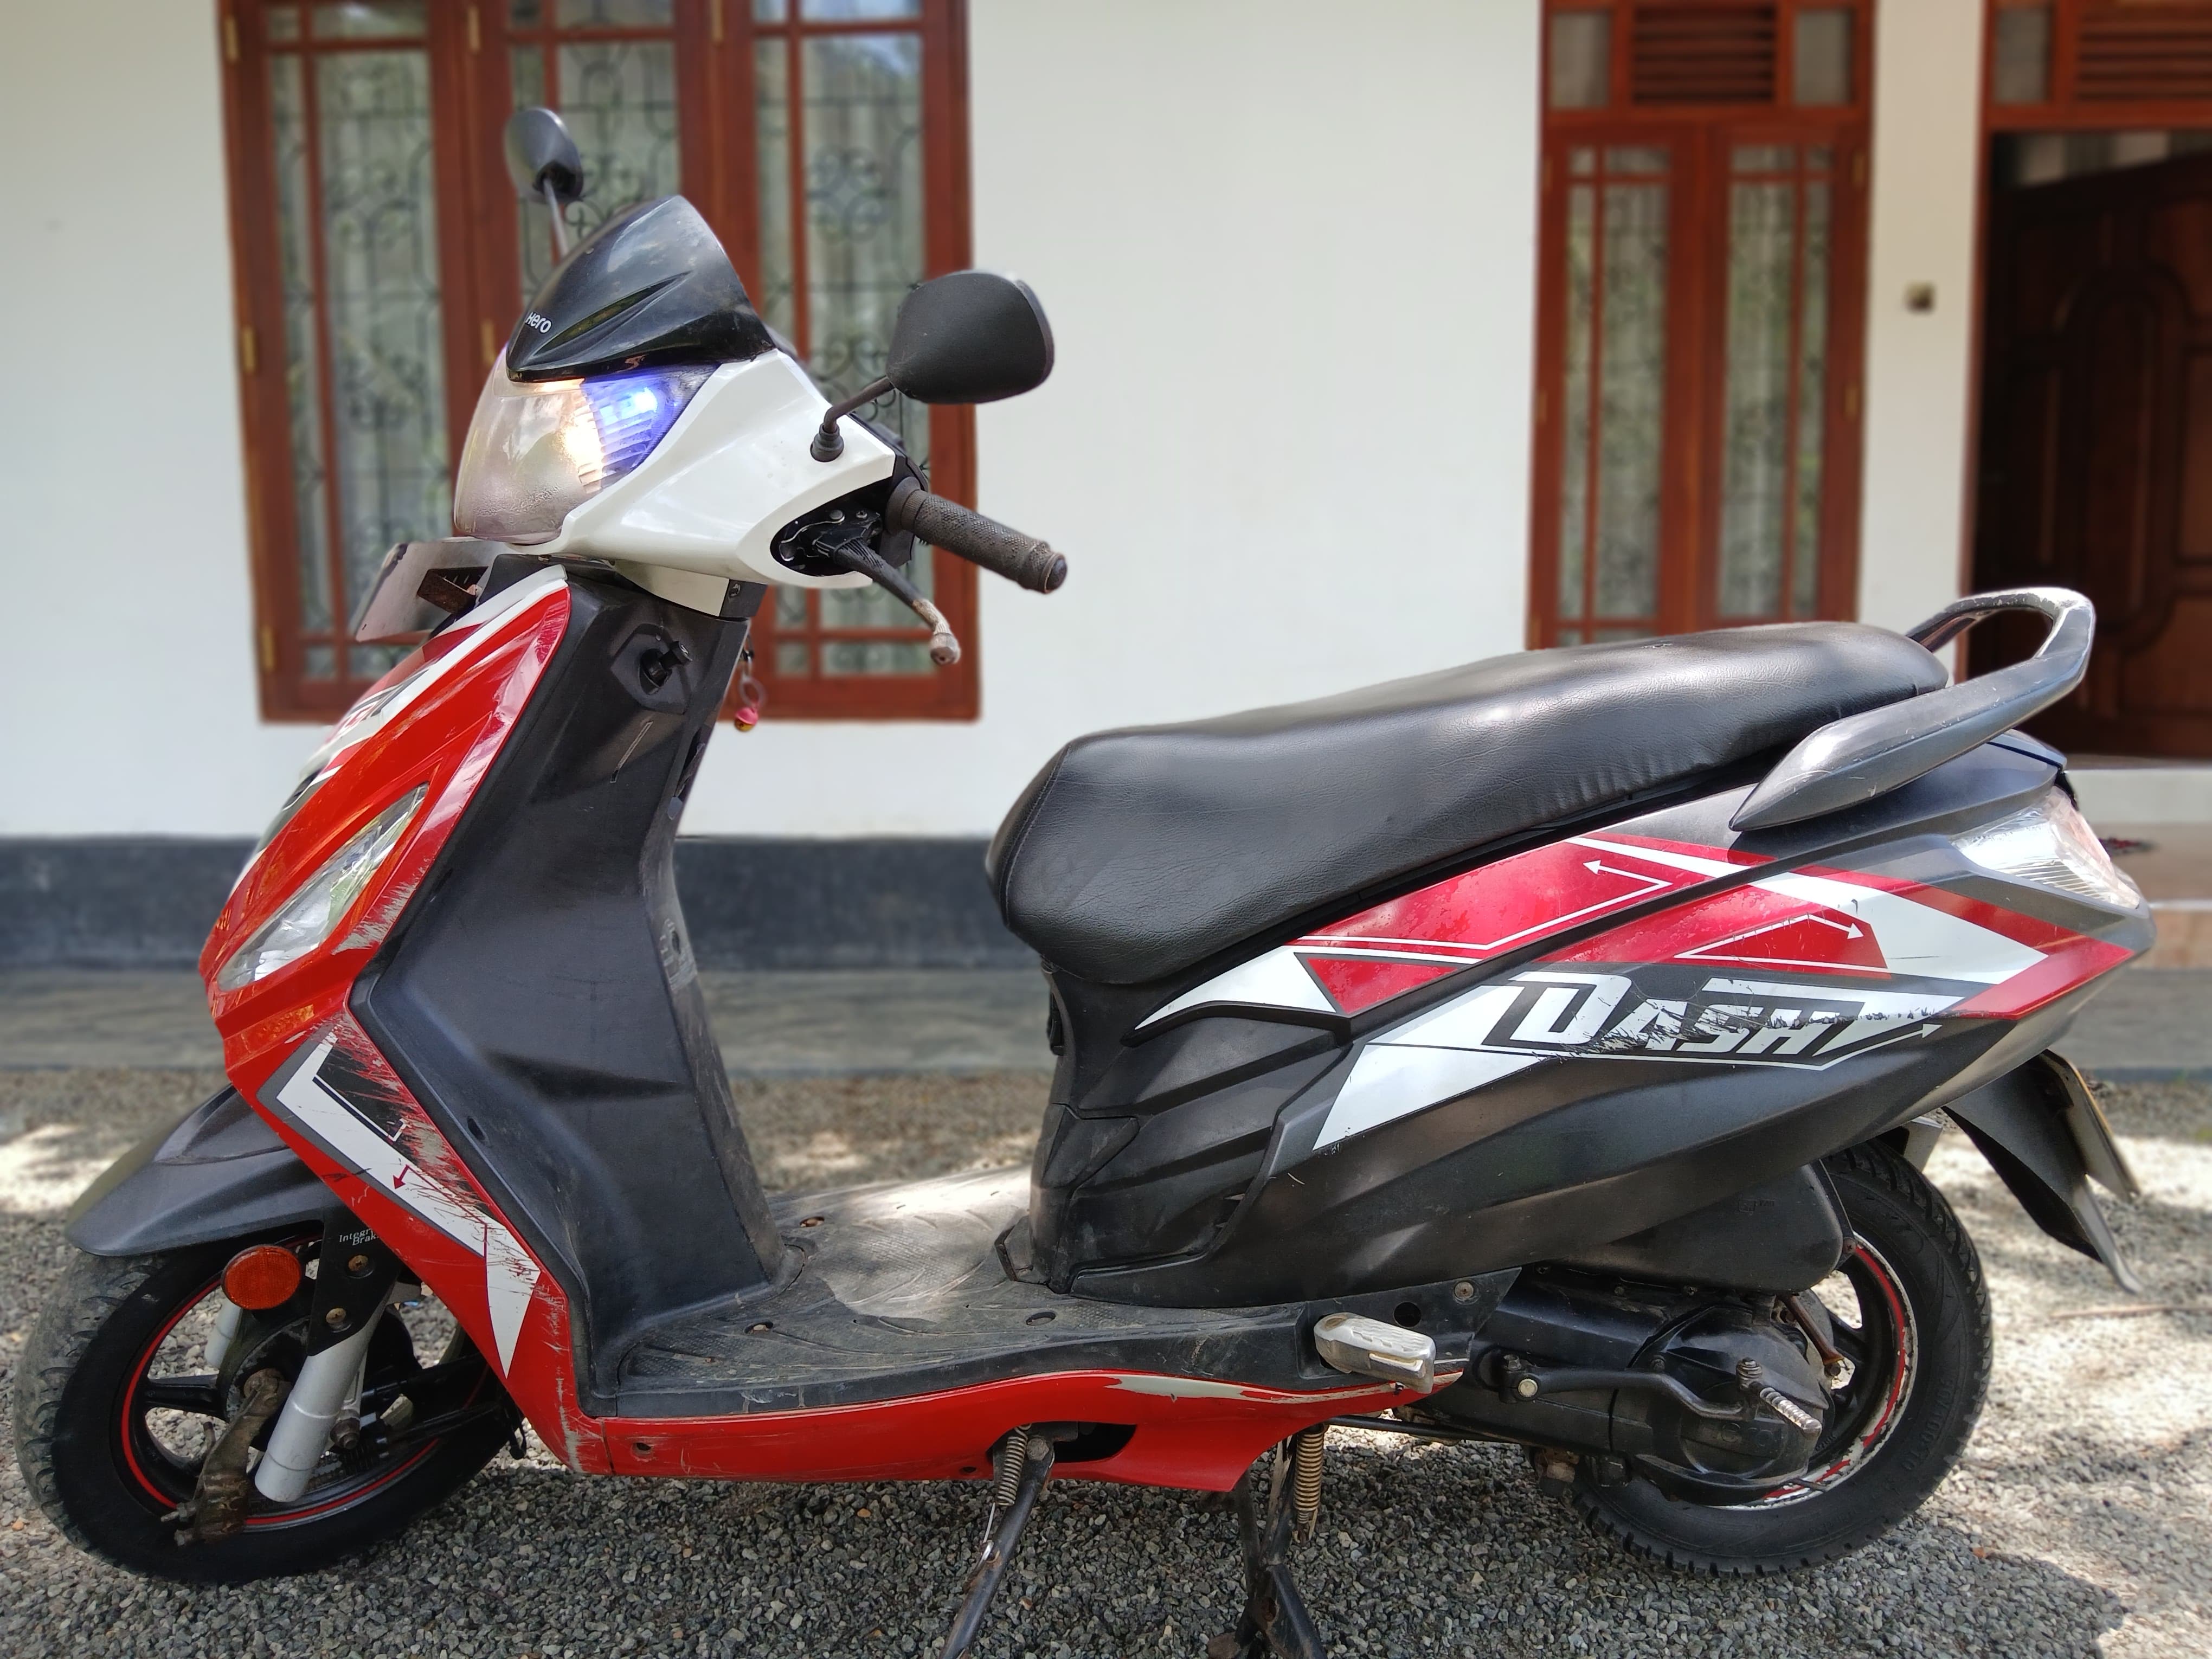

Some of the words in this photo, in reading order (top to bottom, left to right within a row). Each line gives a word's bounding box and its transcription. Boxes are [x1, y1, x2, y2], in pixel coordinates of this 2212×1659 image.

[525, 312, 552, 333] Hero
[1508, 971, 1841, 1054] DASH
[339, 1227, 372, 1243] Integr
[352, 1230, 380, 1246] Brak
